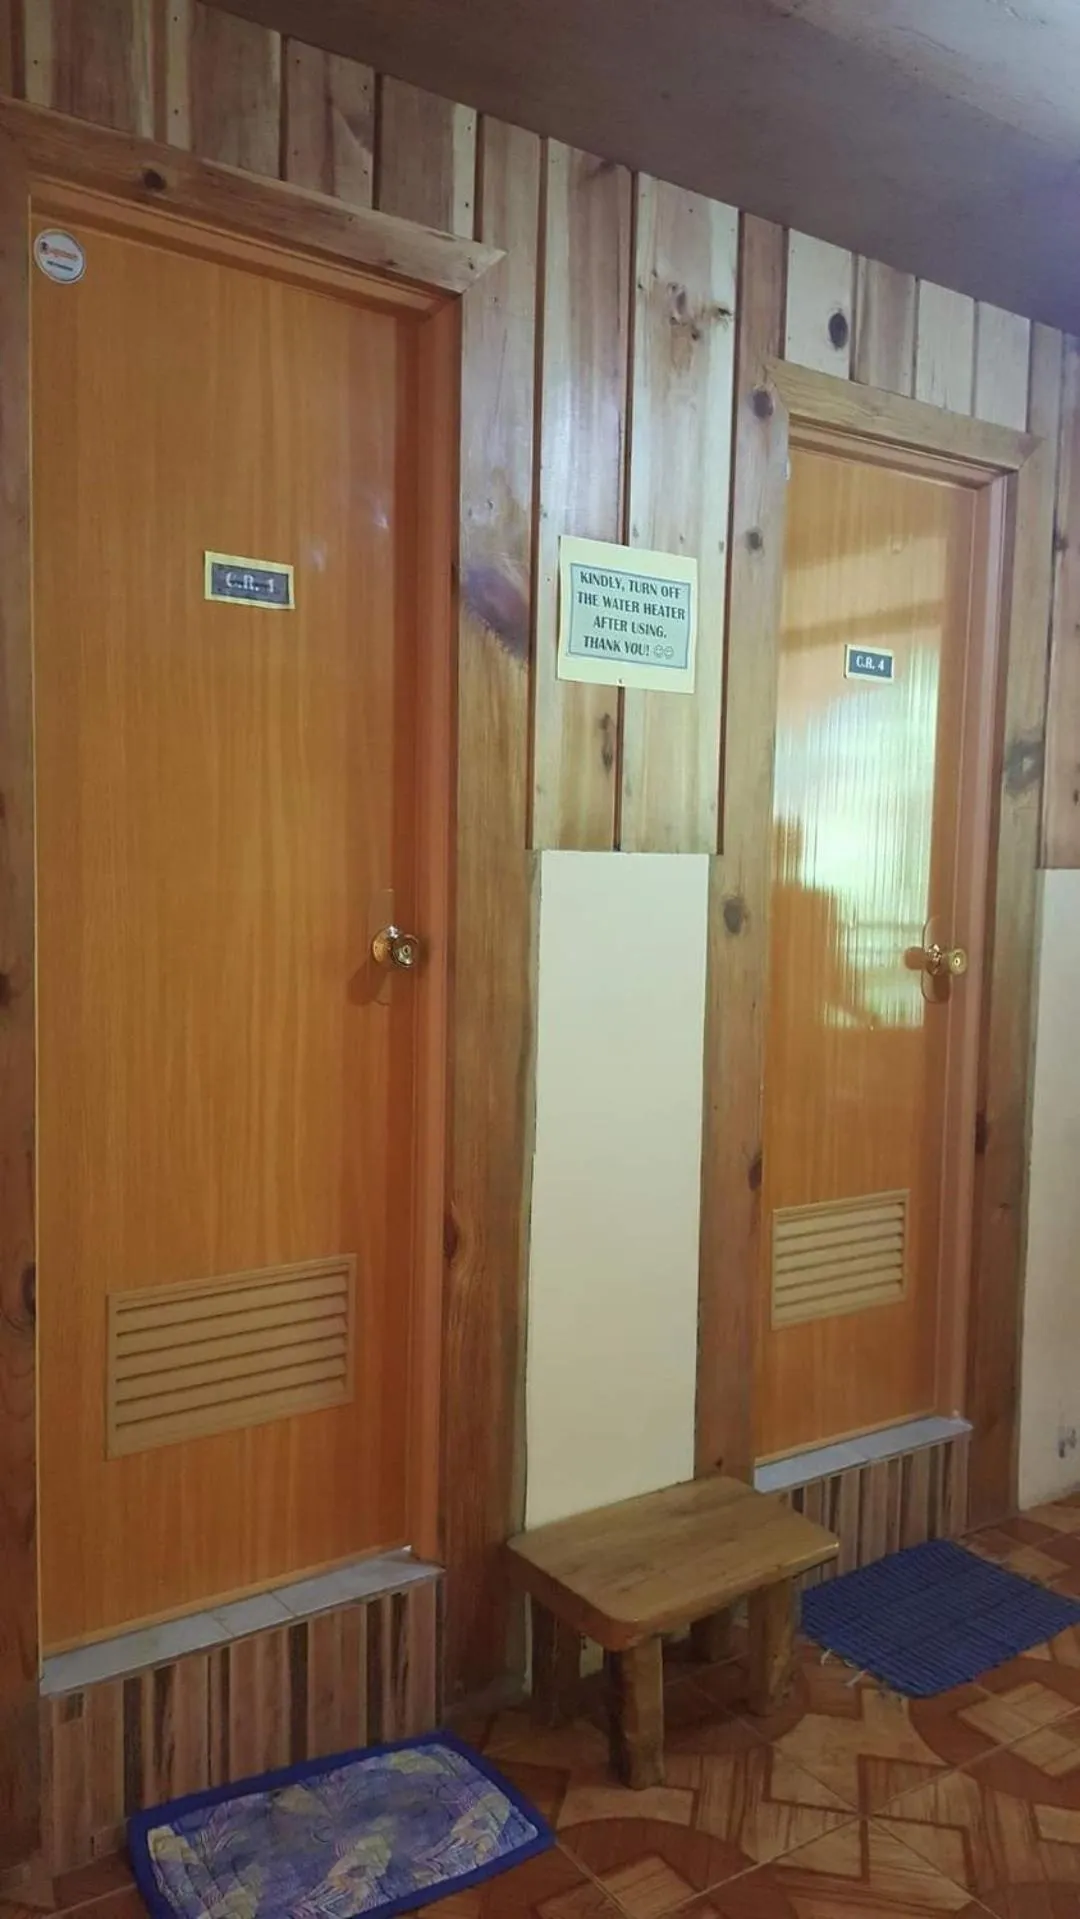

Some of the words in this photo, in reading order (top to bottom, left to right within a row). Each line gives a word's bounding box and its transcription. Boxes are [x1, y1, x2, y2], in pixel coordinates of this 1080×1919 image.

[580, 571, 626, 593] KINDLY,
[629, 579, 658, 596] TURN
[661, 585, 681, 600] OFF
[577, 591, 600, 607] THE
[602, 595, 640, 614] WATER
[643, 602, 686, 621] HEATER
[593, 615, 628, 633] AFTER
[583, 635, 621, 653] THANK
[624, 641, 650, 657] YOU!
[878, 658, 885, 671] 4
